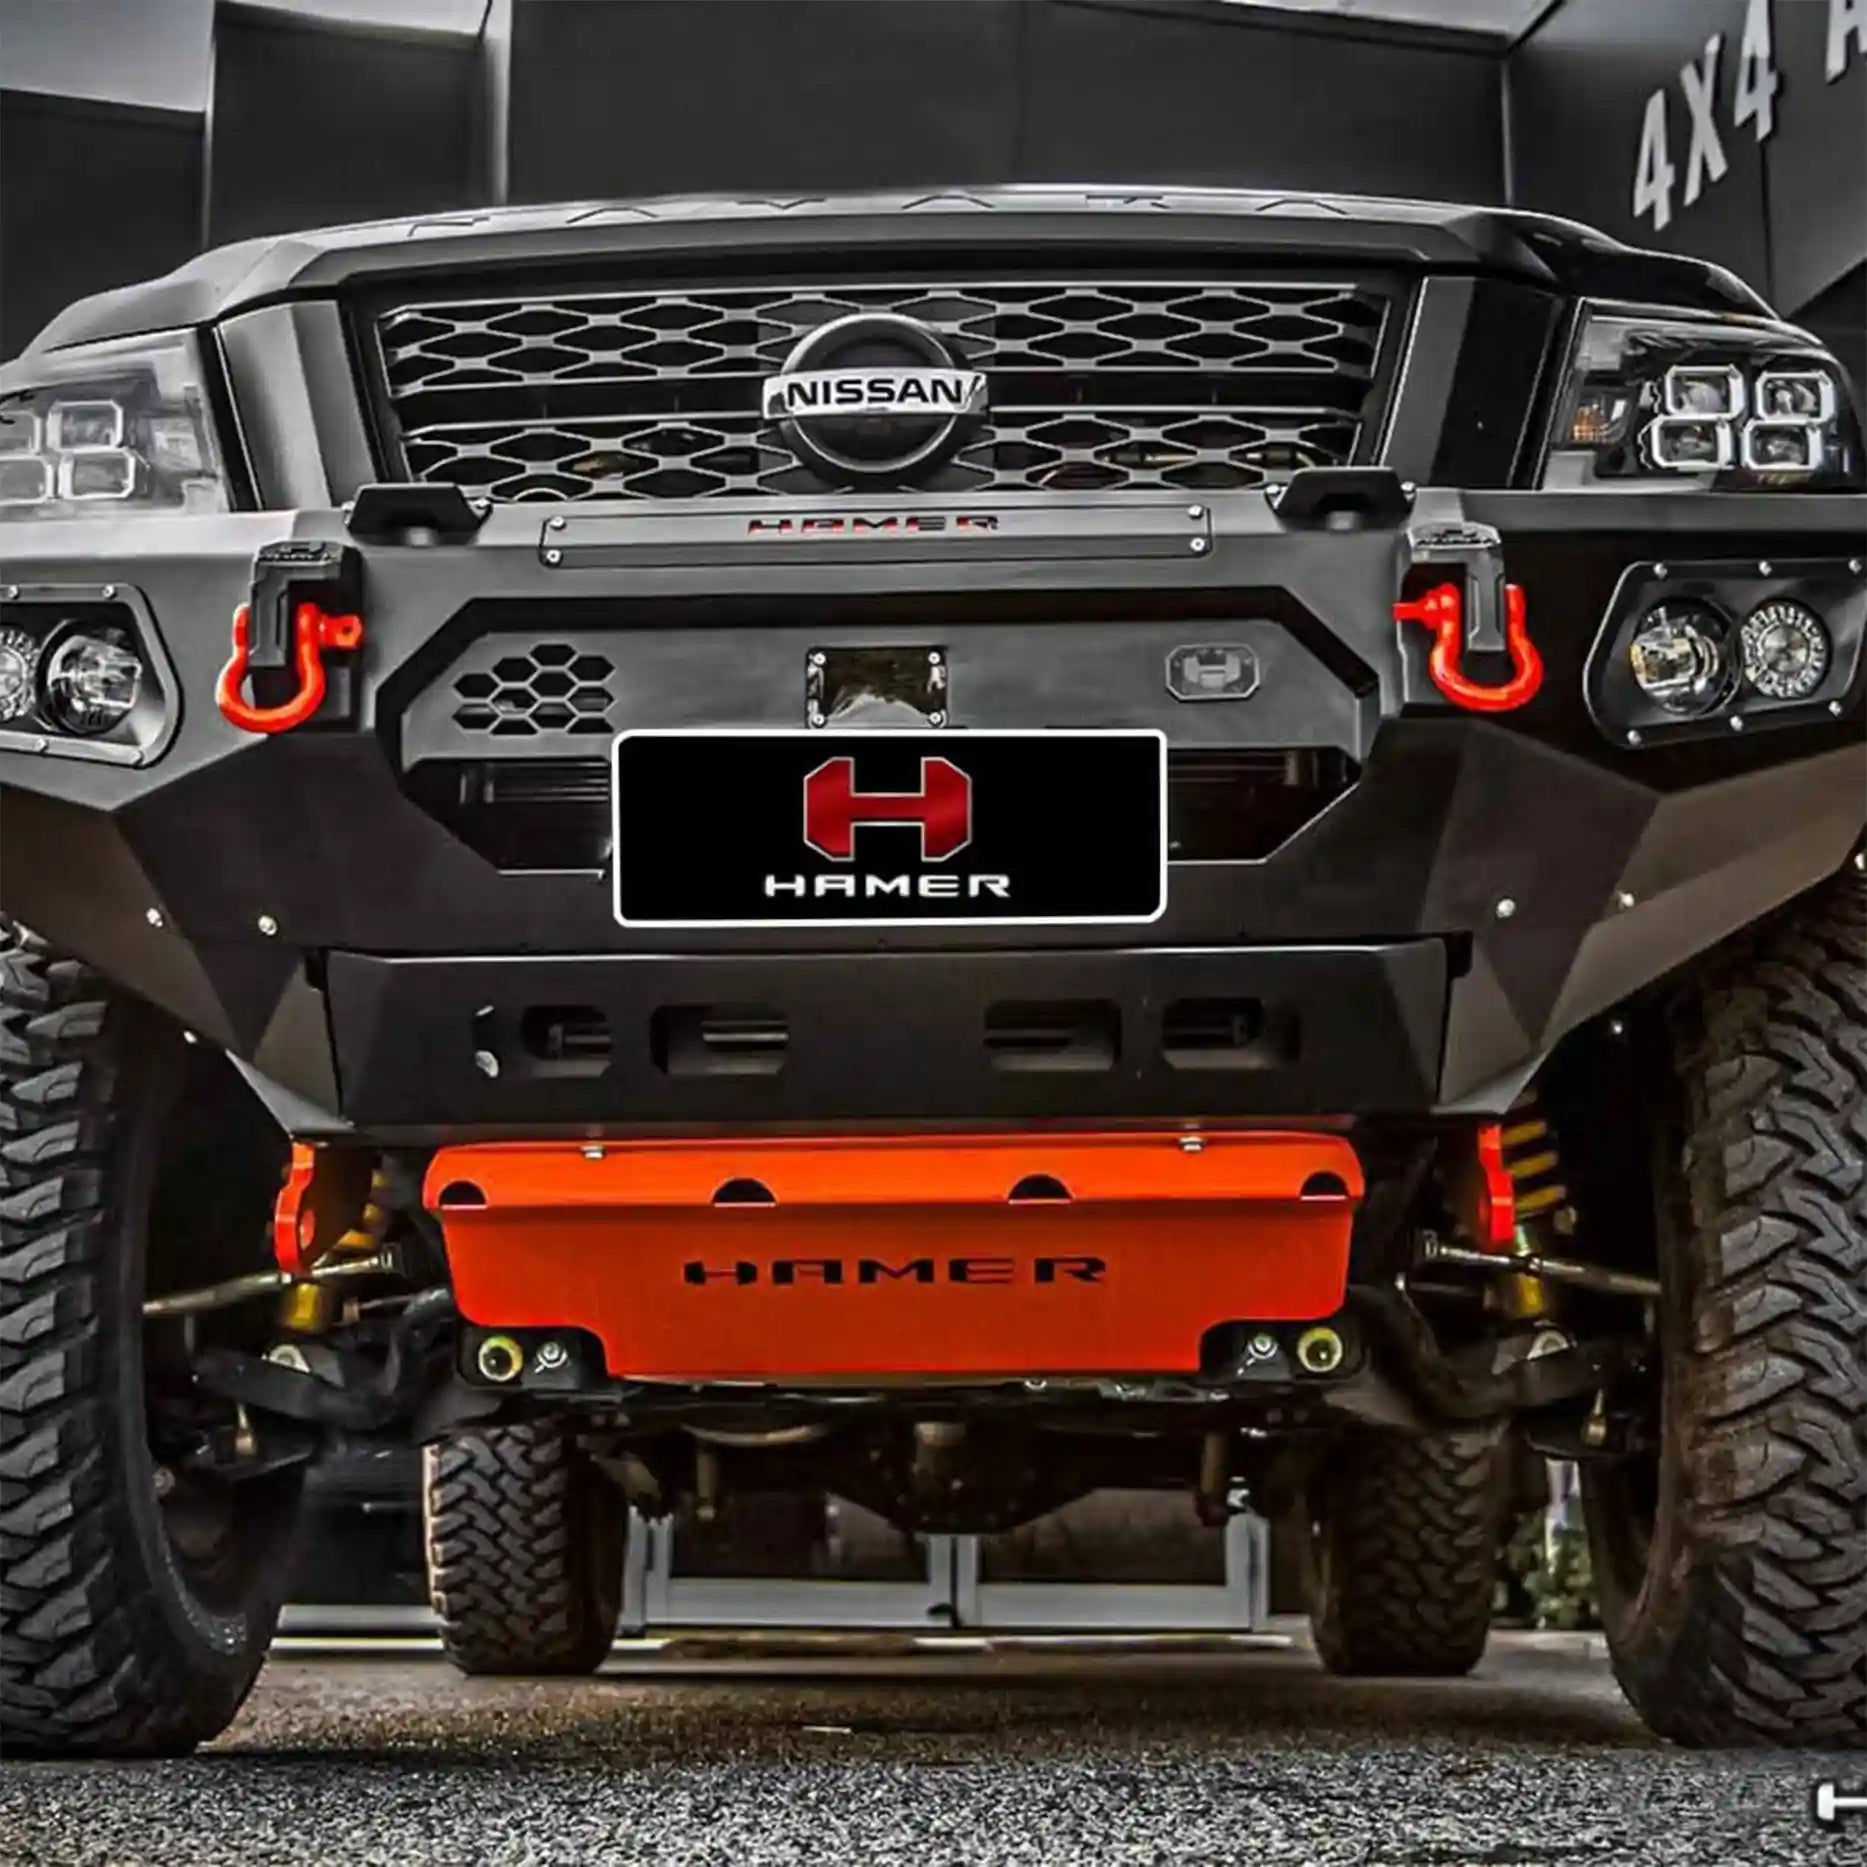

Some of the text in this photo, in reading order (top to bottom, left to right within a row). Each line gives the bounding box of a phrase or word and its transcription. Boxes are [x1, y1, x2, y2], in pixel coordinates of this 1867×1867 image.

[1633, 0, 1777, 232] 4X4
[787, 377, 963, 406] NISSAN
[748, 515, 999, 533] HAMER
[764, 874, 1011, 898] HAMER
[684, 1256, 1107, 1285] HAMER
